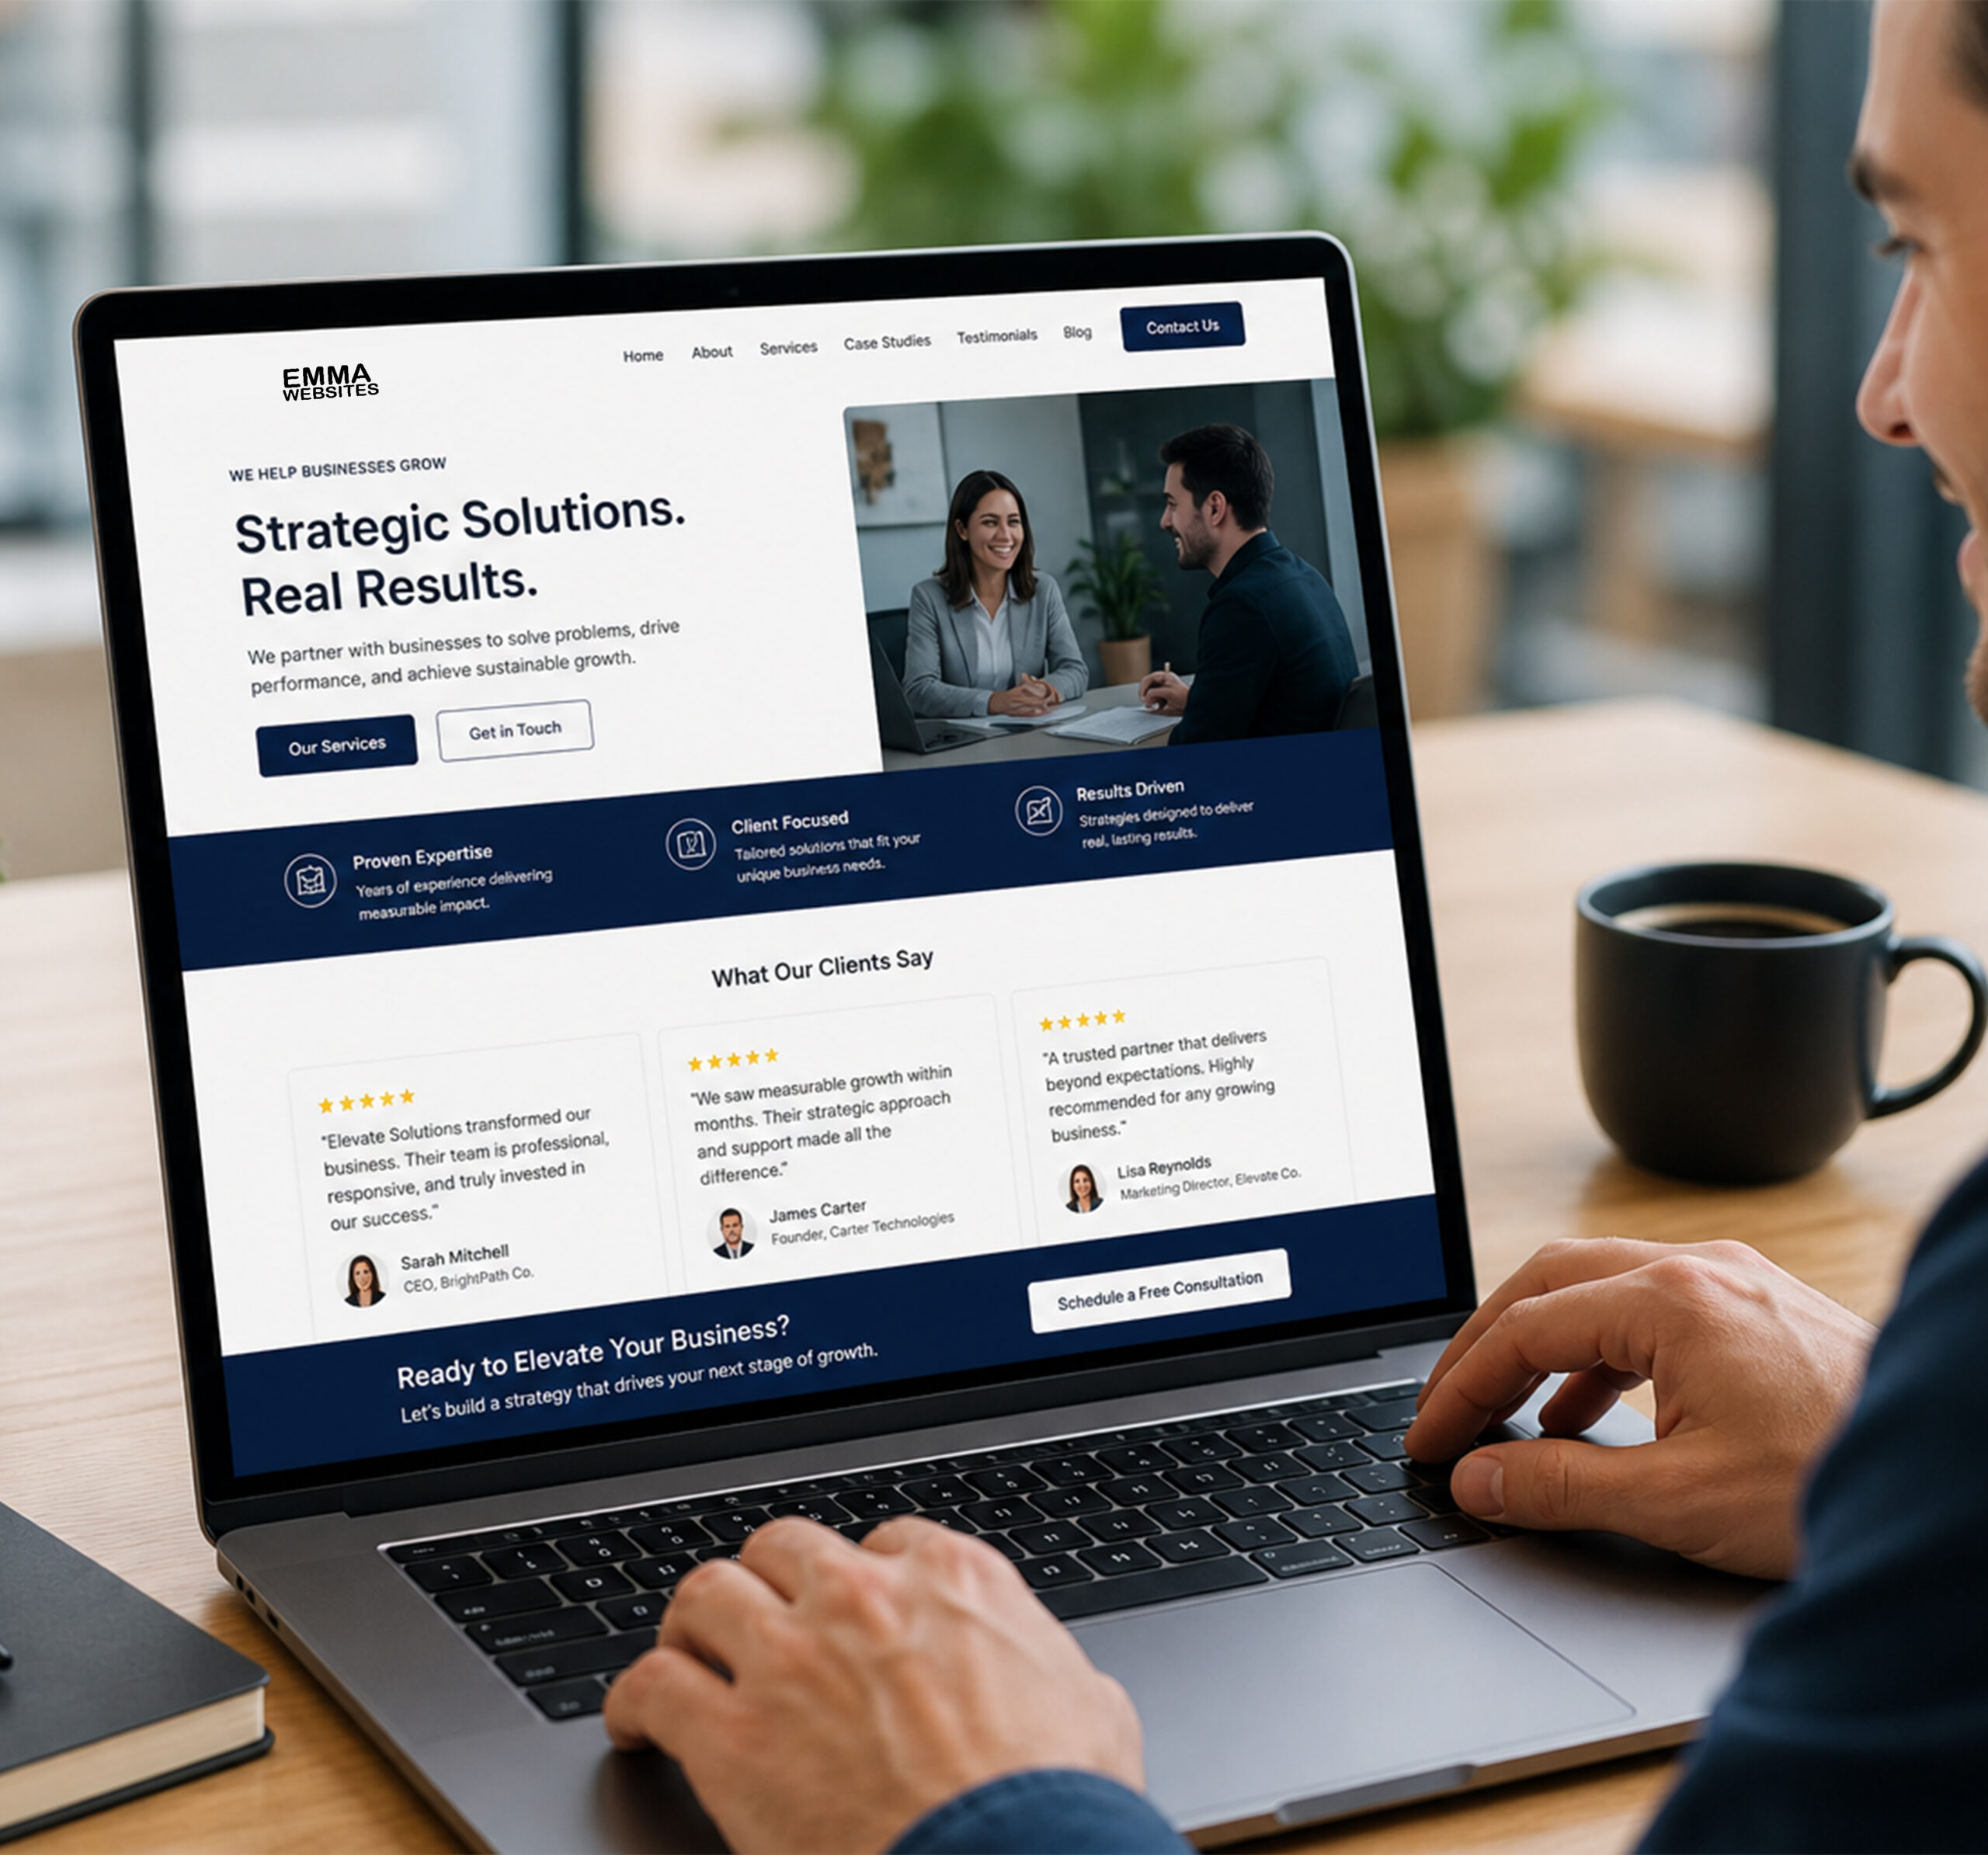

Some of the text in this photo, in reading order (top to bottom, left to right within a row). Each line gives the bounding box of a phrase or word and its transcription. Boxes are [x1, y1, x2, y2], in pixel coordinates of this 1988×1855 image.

[1146, 318, 1220, 335] Contact Us
[623, 325, 1093, 363] Home About Services Case Studies Testimonials Blog
[283, 363, 371, 388] EMMA
[282, 382, 380, 401] WEBSITES
[228, 457, 447, 482] WE HELP BUSINESSES GROW
[235, 492, 685, 555] Strategic Solutions.
[242, 561, 537, 617] Real Results.
[247, 619, 680, 668] We partner with businesses to solve problems, drive
[251, 649, 636, 698] performance, and achieve sustainable growth.
[469, 720, 562, 741] Get in Touch
[288, 737, 387, 756] Our Services
[1076, 780, 1185, 801] Results Driven
[731, 810, 849, 835] Client Focused
[1079, 801, 1254, 828] Strategies designed to deliver
[789, 840, 846, 856] solutions
[847, 837, 874, 850] that
[876, 834, 891, 847] fit
[892, 834, 921, 849] your
[1111, 832, 1152, 846] lasting
[1153, 827, 1197, 842] results.
[353, 845, 493, 870] Proven Expertise
[736, 857, 885, 884] unique business needs.
[356, 869, 554, 898] Years of experience delivering
[359, 897, 490, 921] measurable impact.
[711, 949, 933, 988] What Our Clients Say
[1062, 1044, 1117, 1065] trusted
[1120, 1041, 1174, 1061] partner
[1177, 1036, 1208, 1052] that
[1211, 1031, 1267, 1048] delivers
[724, 1089, 755, 1103] saw
[758, 1077, 847, 1099] measurable
[850, 1070, 904, 1093] growth
[907, 1065, 953, 1082] within
[1045, 1055, 1254, 1093] beyond expectations. Highly
[693, 1090, 951, 1133] months. Their strategic approach
[1048, 1080, 1276, 1117] recommended for any growing
[388, 1123, 463, 1142] Solutions
[465, 1108, 562, 1134] transformed
[565, 1108, 591, 1122] our
[323, 1131, 610, 1177] business. Their team is professional,
[697, 1124, 891, 1160] and support made all the
[327, 1160, 586, 1204] responsive, and truly invested in
[1117, 1155, 1212, 1179] Lisa Reynolds
[1120, 1167, 1302, 1200] Marketing Director, Elevate Co.
[330, 1217, 358, 1231] our
[769, 1201, 867, 1224] James Carter
[771, 1213, 955, 1245] Founder, Carter Technologies
[401, 1243, 509, 1271] Sarah Mitchell
[403, 1266, 534, 1294] CEO, BrightPath Co.
[1057, 1271, 1263, 1311] Schedule a Free Consultation
[398, 1314, 790, 1389] Ready to Elevate Your Business?
[401, 1343, 878, 1423] Let's build a strategy that drives your next stage of growth.
